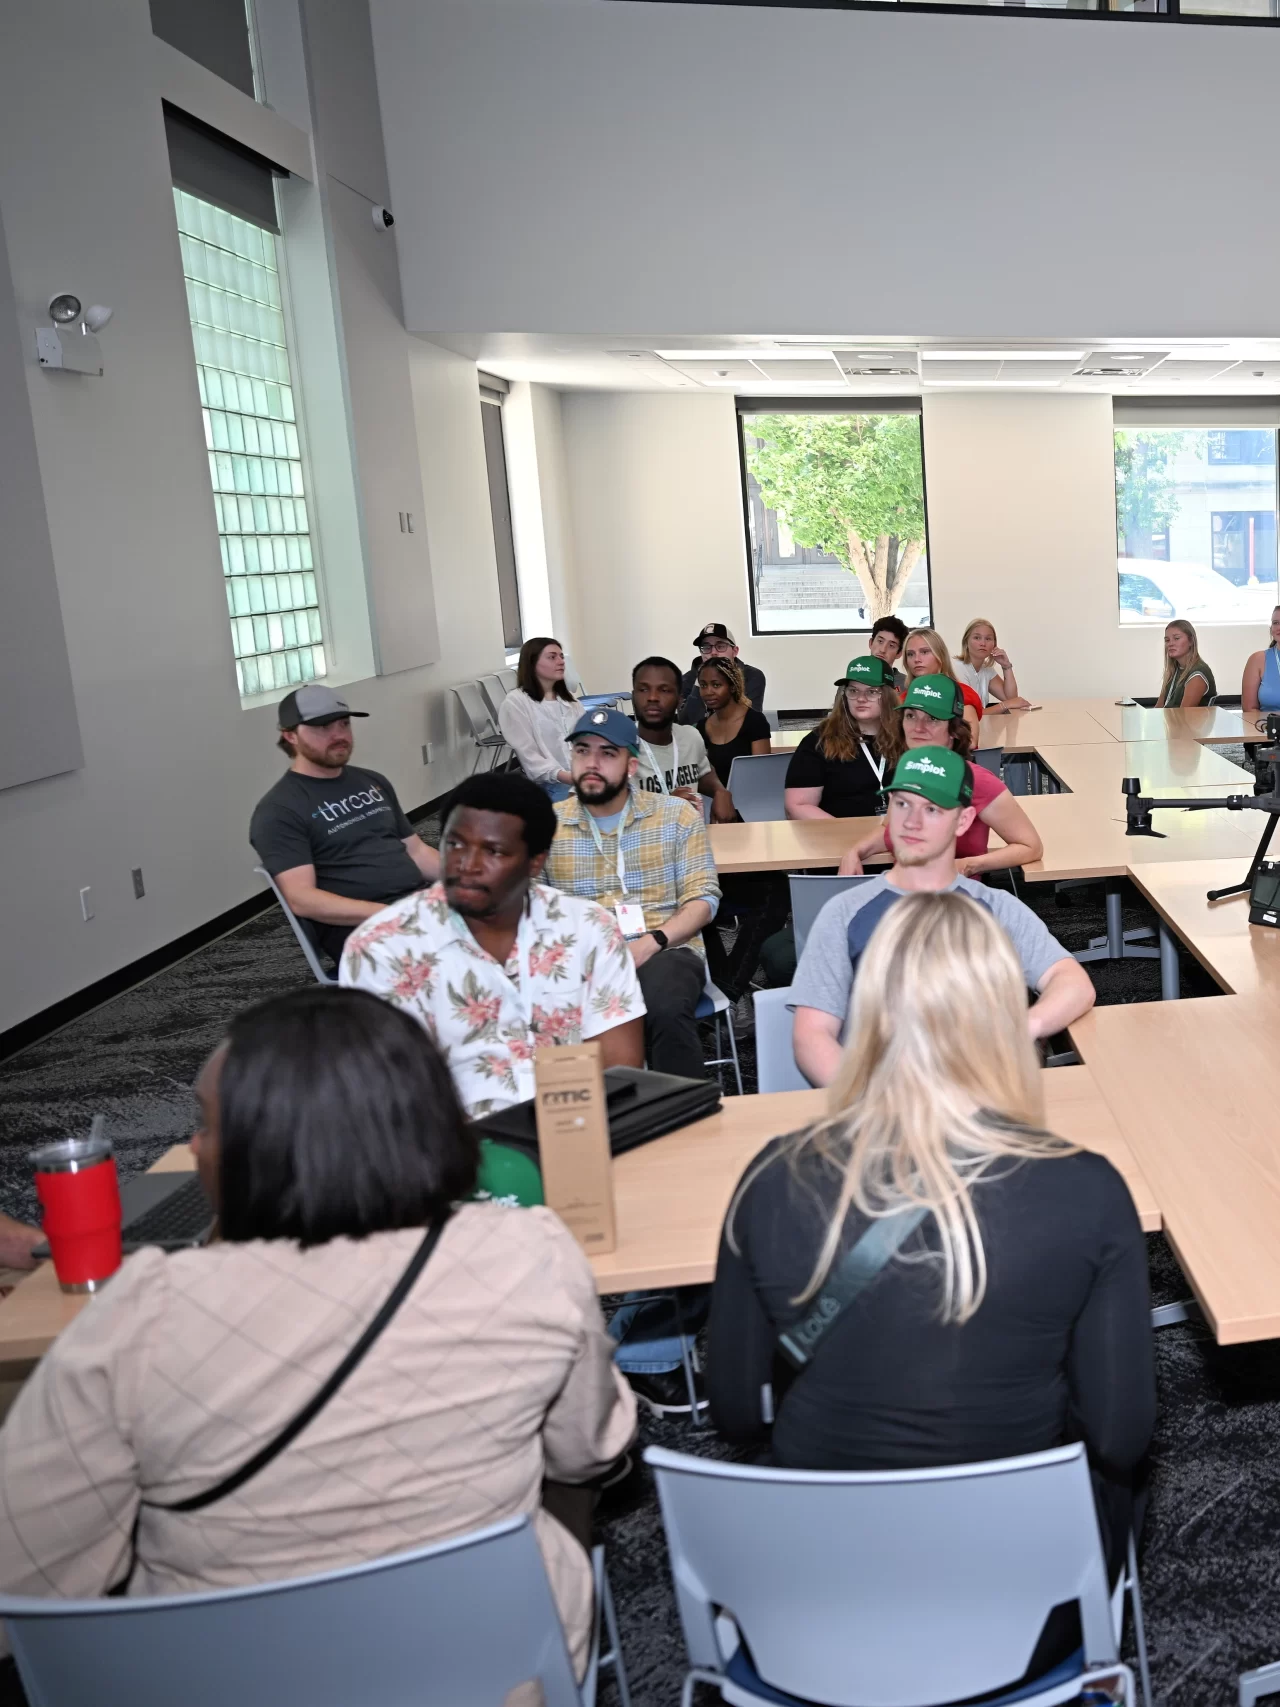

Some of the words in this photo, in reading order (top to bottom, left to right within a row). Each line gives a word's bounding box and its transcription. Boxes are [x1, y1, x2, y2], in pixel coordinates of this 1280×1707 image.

[850, 665, 871, 673] Simplot
[913, 686, 942, 699] Simplot
[904, 760, 946, 777] Simplot
[639, 774, 662, 793] LOS
